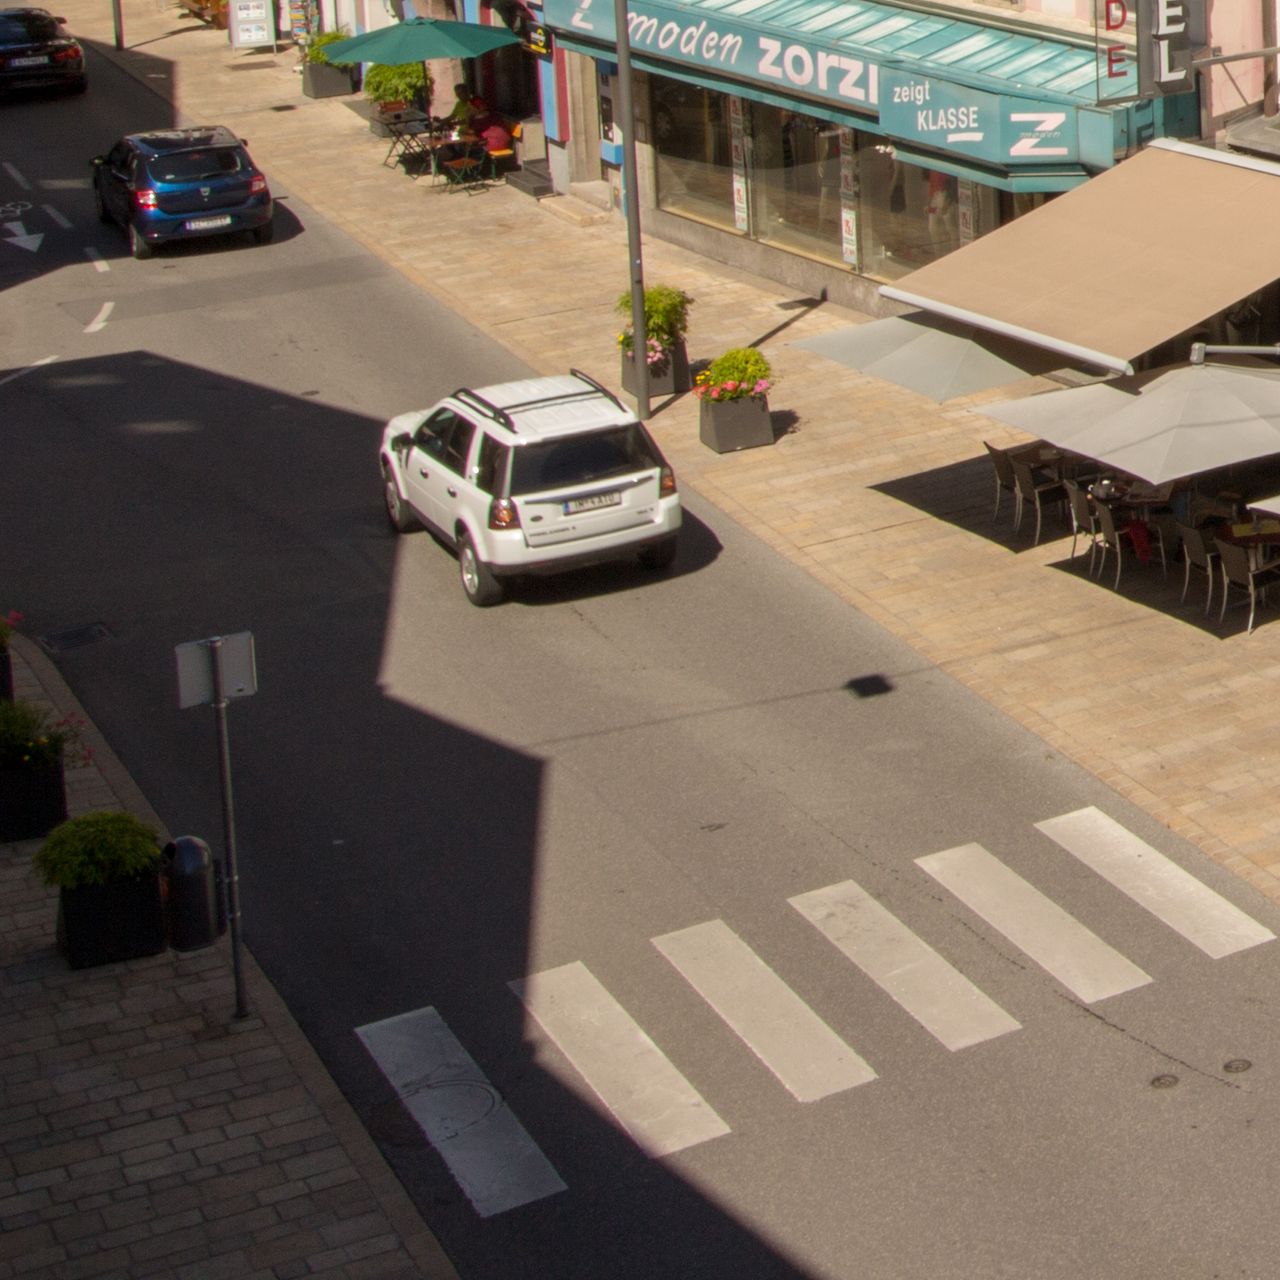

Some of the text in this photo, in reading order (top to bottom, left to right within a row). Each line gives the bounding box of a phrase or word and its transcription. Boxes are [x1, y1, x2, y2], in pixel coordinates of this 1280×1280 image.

[627, 11, 742, 65] moden
[893, 81, 930, 105] zeigt
[917, 107, 979, 132] KLASSE
